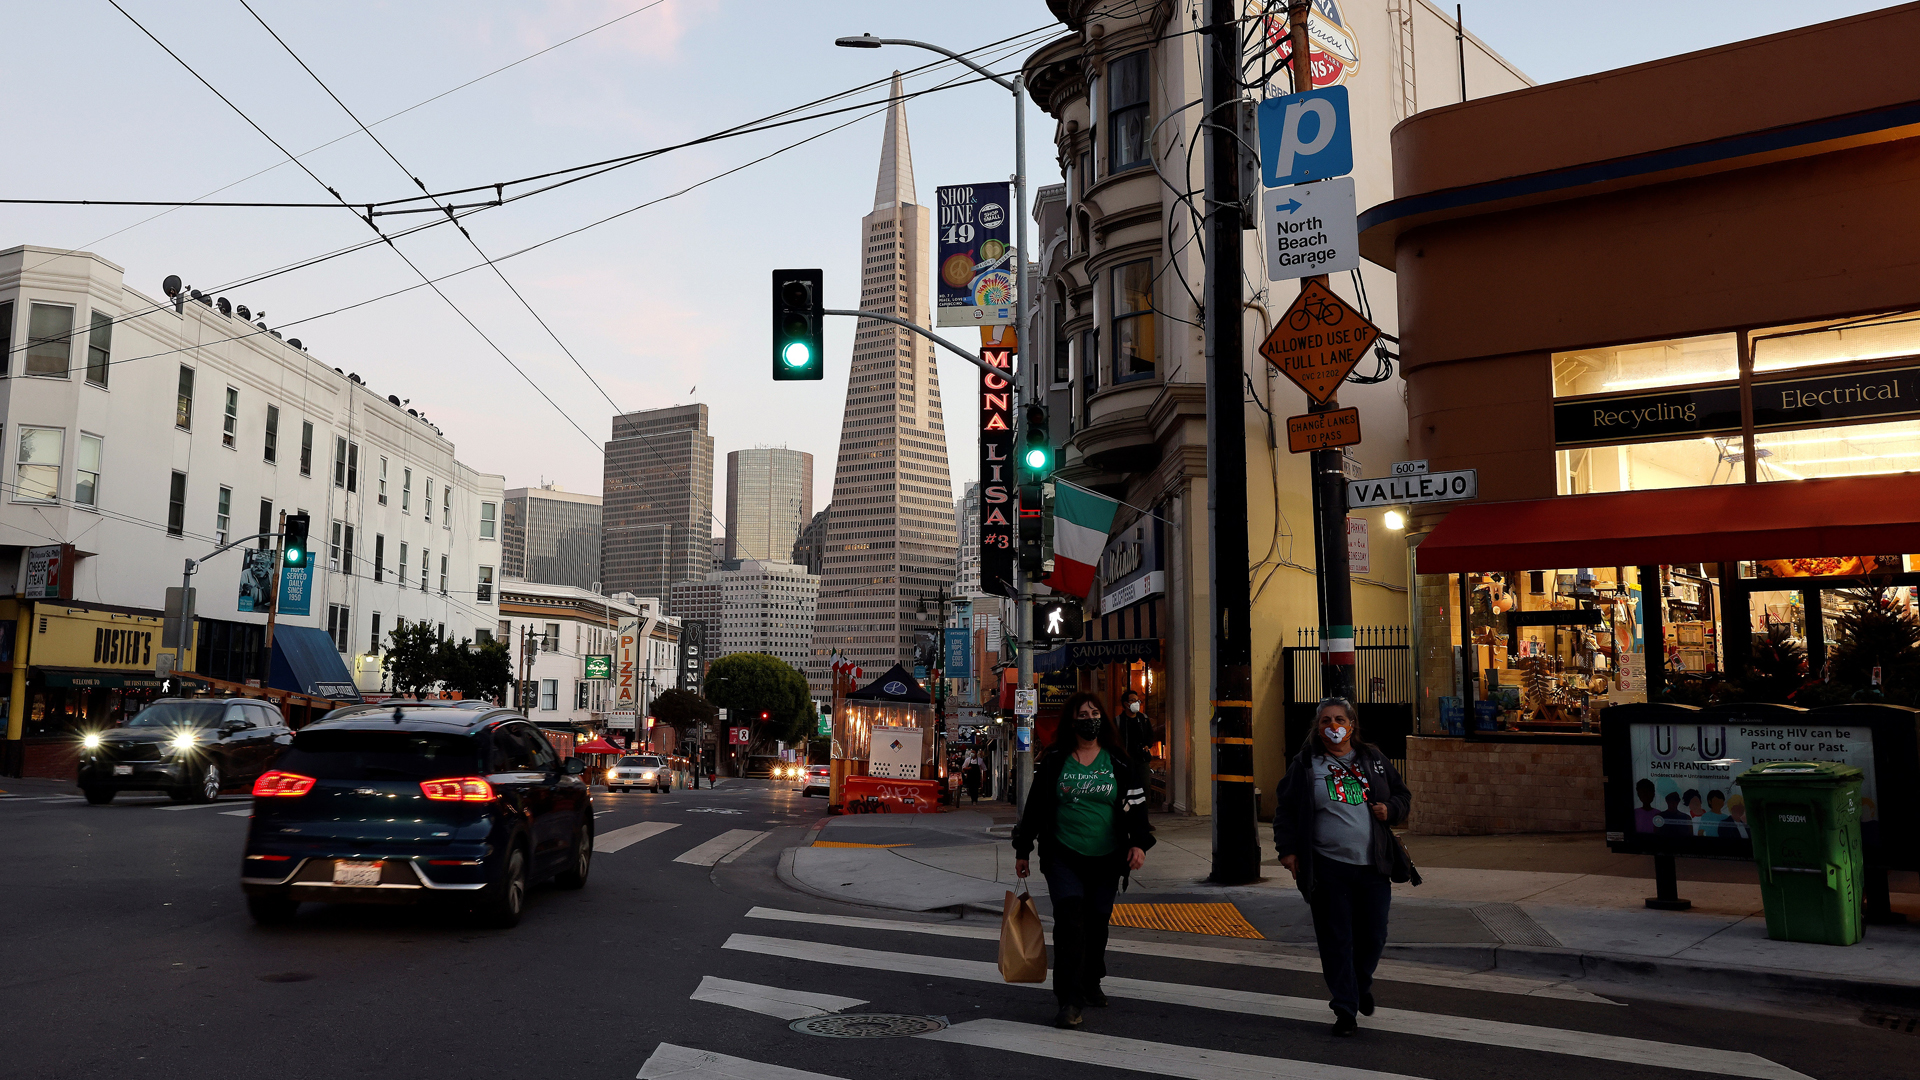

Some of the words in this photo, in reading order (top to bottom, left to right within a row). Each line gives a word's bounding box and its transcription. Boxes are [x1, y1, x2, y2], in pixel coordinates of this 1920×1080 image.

[941, 187, 974, 206] SHOP
[941, 204, 974, 226] DINE
[983, 210, 999, 218] SHOP
[983, 214, 1001, 223] SMALL
[941, 223, 975, 245] 49
[1277, 216, 1323, 236] North
[1278, 231, 1328, 251] Beach
[1278, 248, 1336, 267] Garage
[1267, 334, 1323, 355] ALLOWED
[1327, 330, 1350, 346] USE
[1354, 327, 1369, 341] OF
[1284, 354, 1315, 371] FULL
[1321, 348, 1354, 366] LANE
[1302, 372, 1315, 382] CVC
[1316, 369, 1339, 379] 21202
[984, 351, 1010, 431] MONA
[1781, 379, 1900, 410] Electrical
[1593, 401, 1697, 429] Recycling
[1291, 418, 1324, 433] CHANGE
[1327, 414, 1356, 428] LANES
[1306, 434, 1316, 444] TO
[1320, 430, 1342, 442] PASS
[1396, 463, 1415, 473] 600
[984, 443, 1010, 526] LISA
[1355, 476, 1467, 503] VALLEJO
[1350, 522, 1367, 534] PARKING
[984, 533, 1009, 549] #3
[1348, 551, 1367, 561] EDNESDAY
[28, 560, 47, 573] CHEESE
[28, 573, 44, 585] STEAK
[286, 572, 307, 581] SERVED
[288, 579, 304, 588] DAILY
[93, 627, 152, 665] BUSTER'S
[1072, 642, 1152, 658] SANDWICHES
[619, 635, 634, 700] PIZZA
[1740, 727, 1784, 740] Passing
[1787, 728, 1807, 738] HIV
[1810, 729, 1832, 738] can
[1836, 728, 1851, 739] be
[1677, 743, 1697, 752] equals
[1751, 741, 1776, 750] Part
[1779, 741, 1792, 751] of
[1794, 743, 1815, 752] our
[1818, 742, 1848, 753] Past.
[1650, 761, 1671, 770] SAN
[1673, 762, 1730, 772] FRANCISCO
